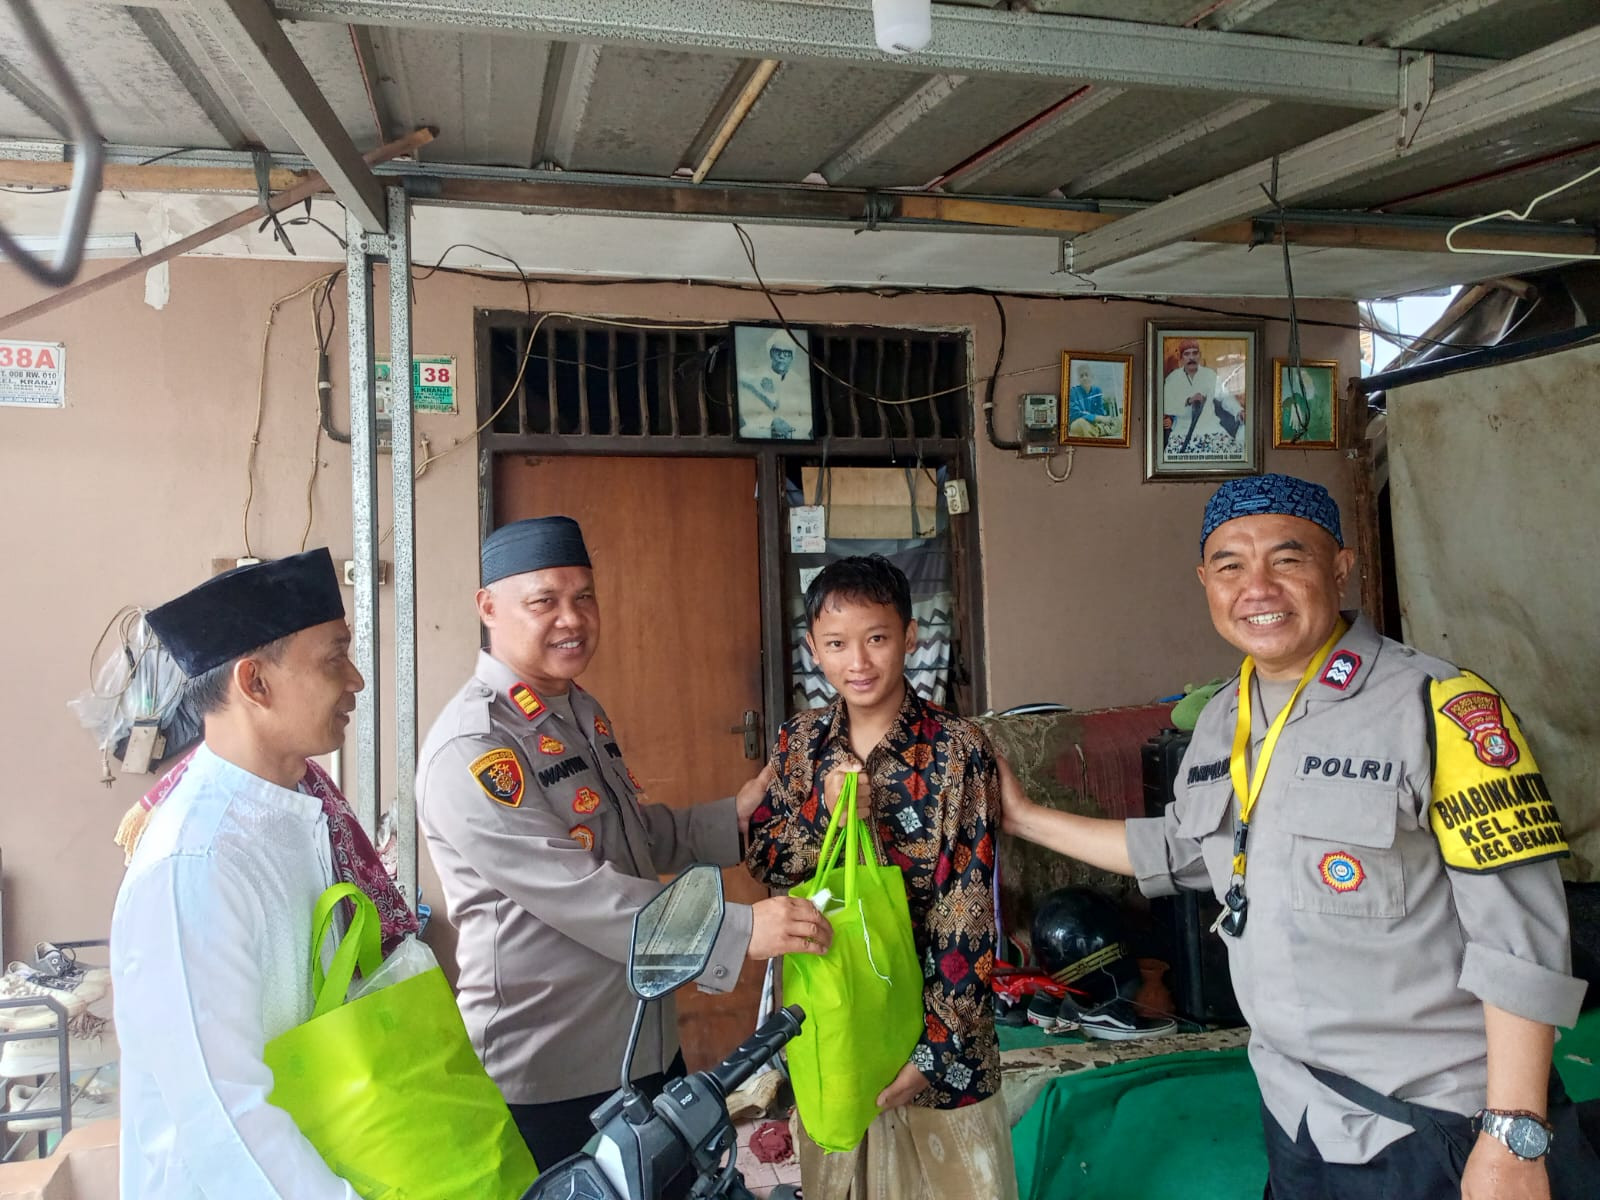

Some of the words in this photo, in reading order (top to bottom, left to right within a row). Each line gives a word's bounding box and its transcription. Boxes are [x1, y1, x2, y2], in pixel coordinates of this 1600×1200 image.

[0, 347, 55, 369] 38A
[424, 367, 450, 383] 38
[1303, 756, 1393, 782] POLRI
